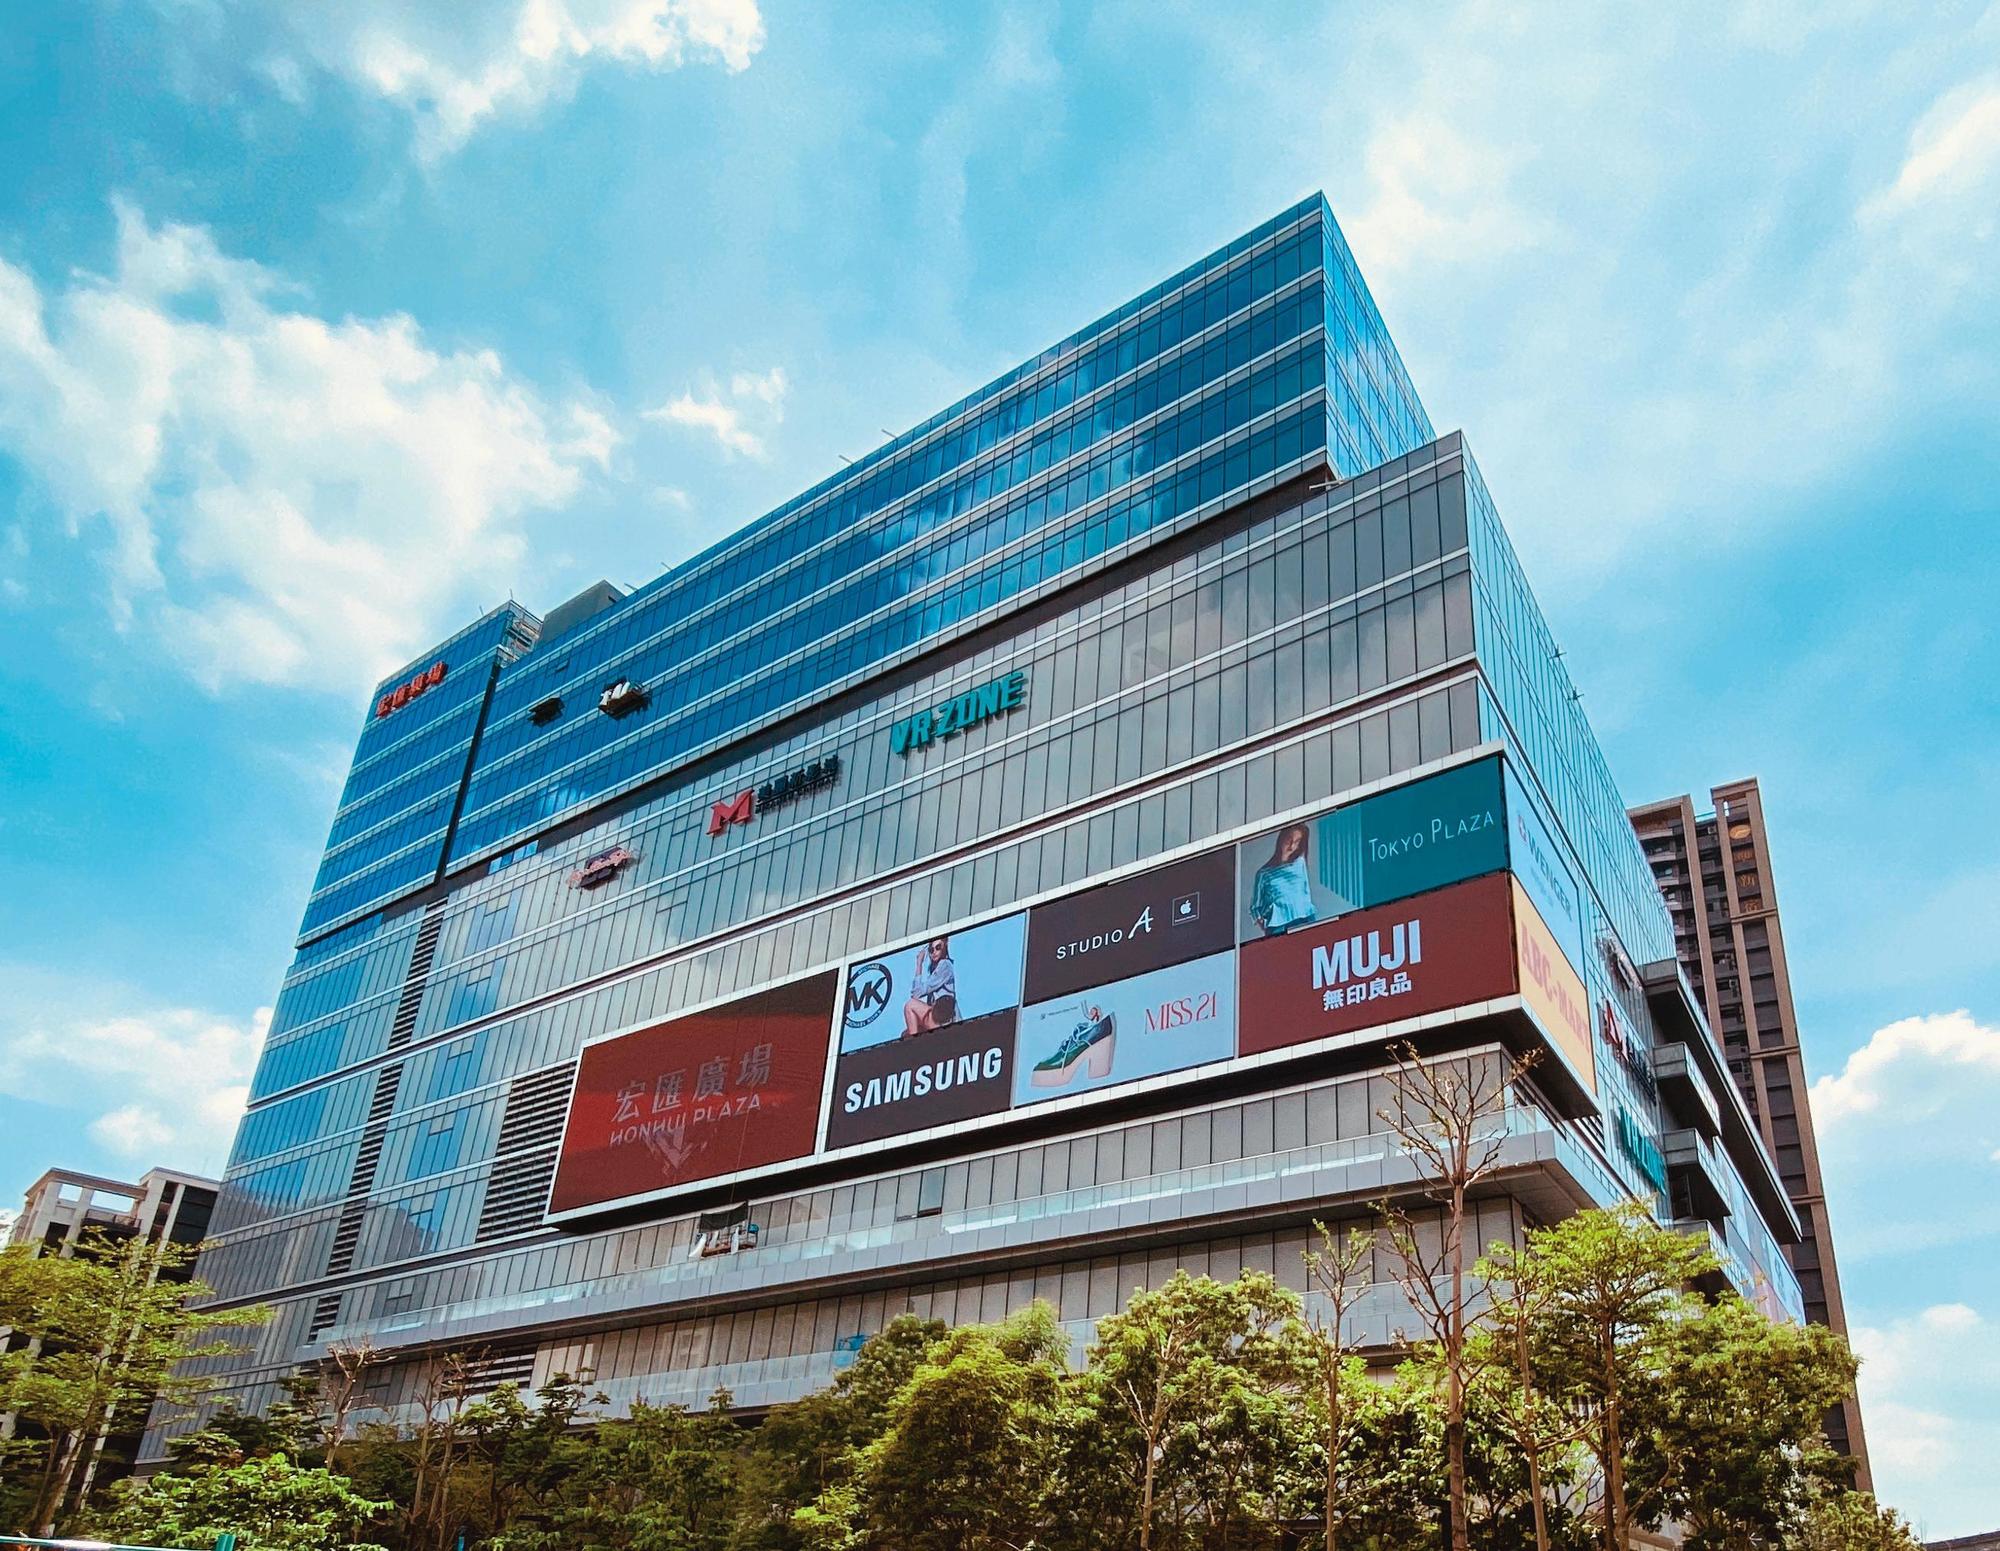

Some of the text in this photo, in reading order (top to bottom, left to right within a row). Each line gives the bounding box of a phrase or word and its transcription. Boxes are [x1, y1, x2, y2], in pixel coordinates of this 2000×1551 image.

[1368, 810, 1495, 862] TOKYO PLAZA
[1056, 929, 1123, 960] STUDIO
[1312, 919, 1422, 990] MUJI
[1322, 971, 1412, 1012] 無印良品
[1144, 999, 1193, 1035] MISS
[611, 1043, 773, 1123] 宏匯廣場
[843, 1047, 1003, 1113] SAMSUNG
[692, 1093, 762, 1124] PLAZA
